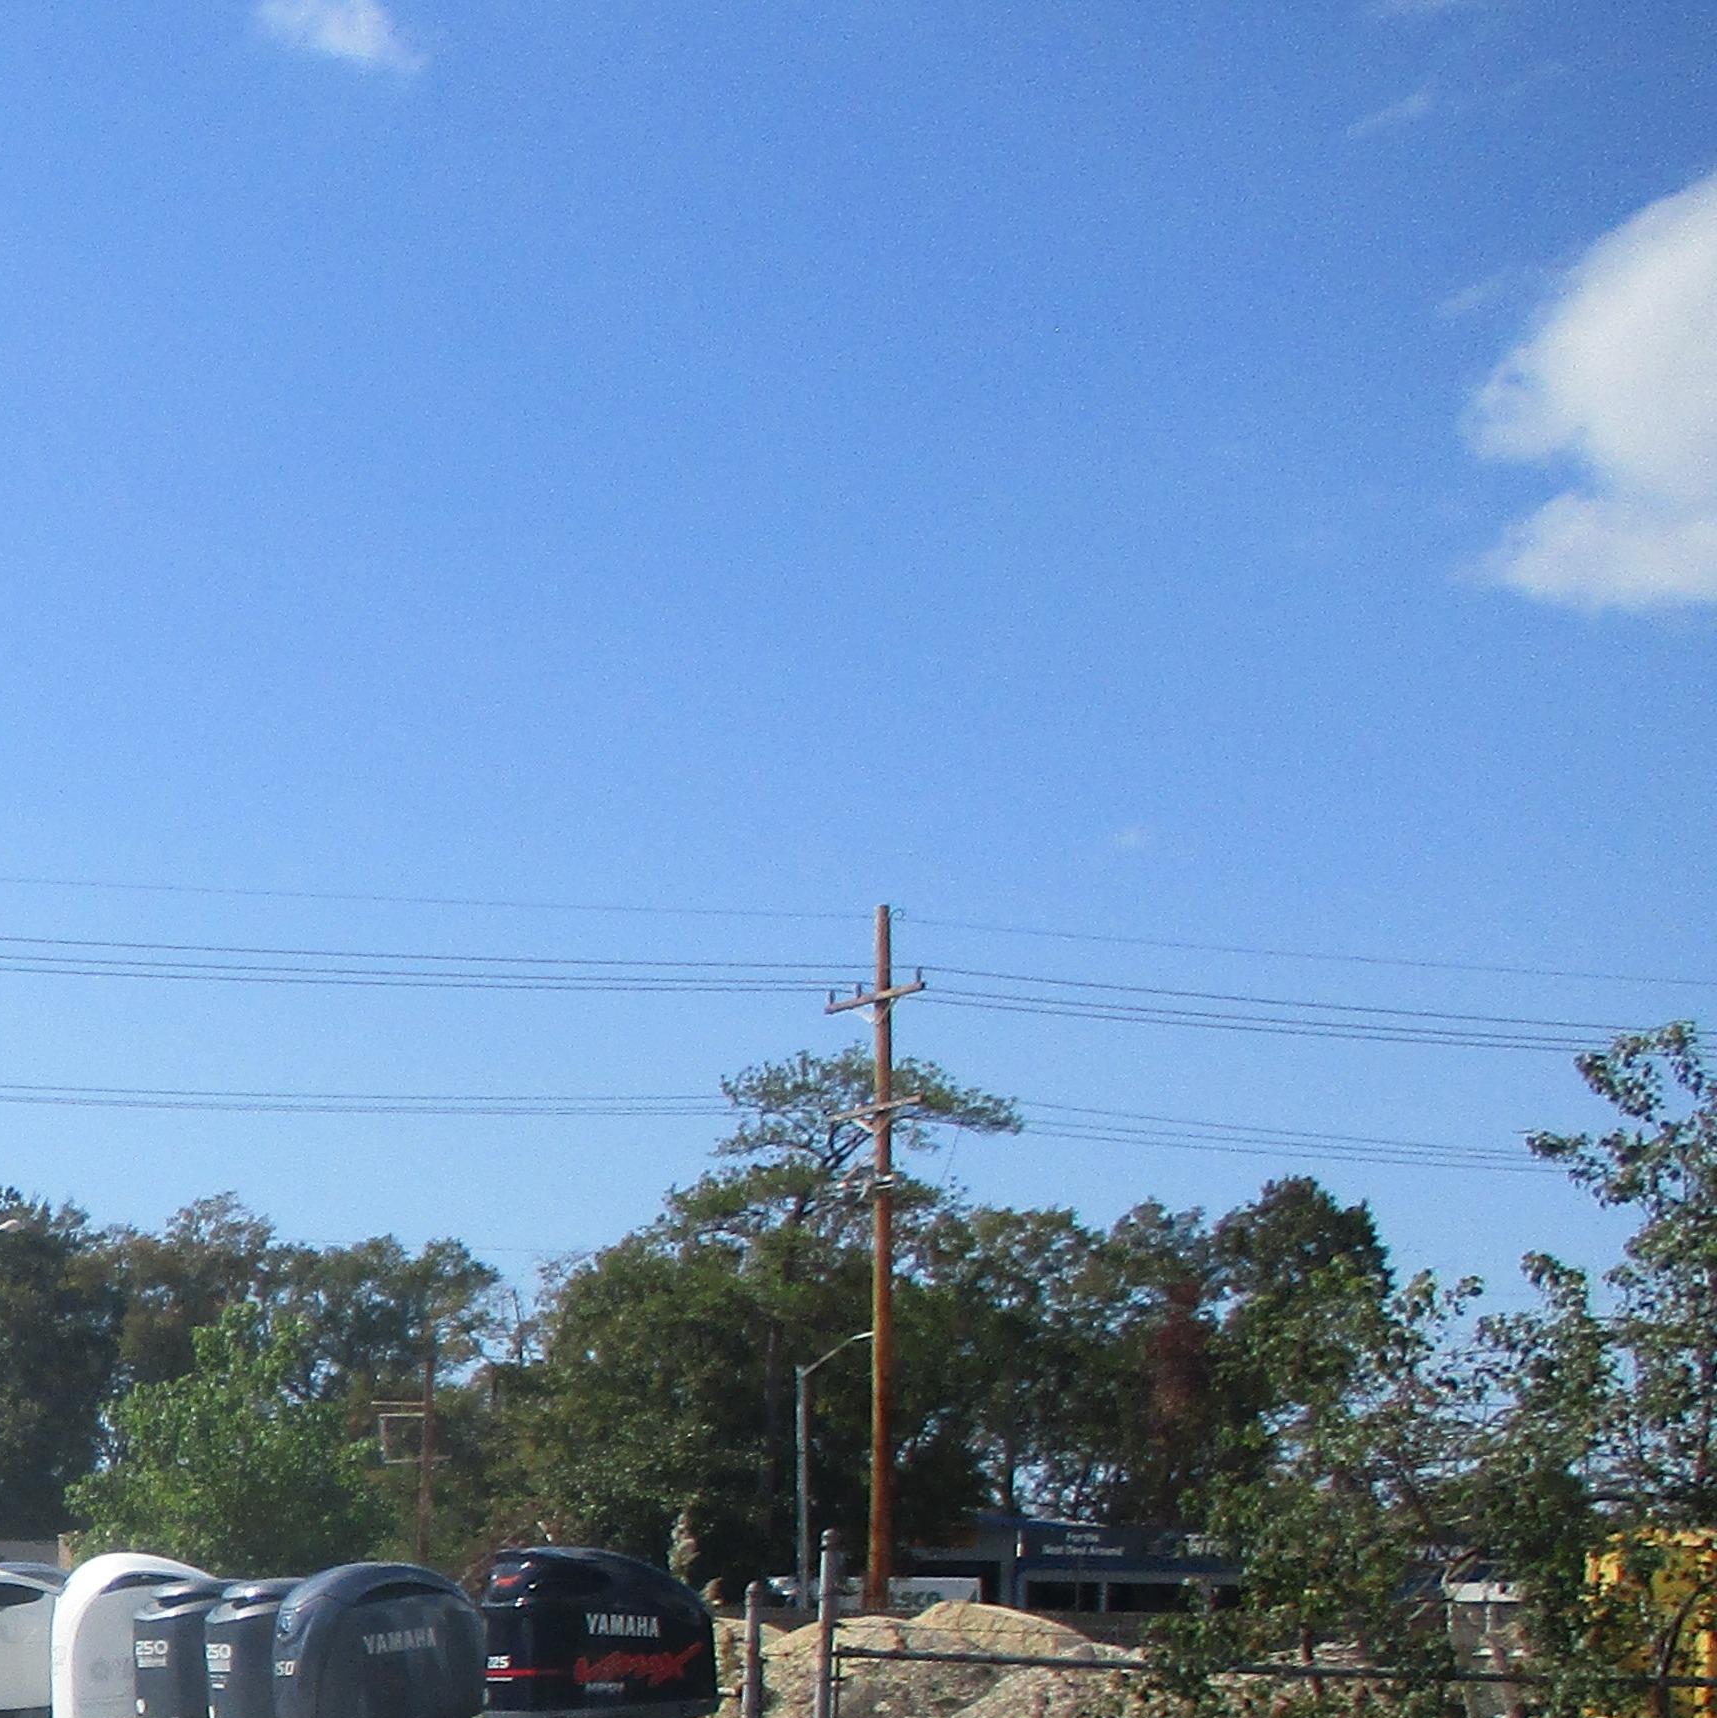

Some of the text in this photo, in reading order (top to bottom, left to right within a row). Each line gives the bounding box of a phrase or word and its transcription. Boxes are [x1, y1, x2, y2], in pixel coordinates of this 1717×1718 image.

[584, 1611, 662, 1639] YAMAHA
[135, 1640, 169, 1656] 250
[362, 1626, 437, 1655] YAMAHA
